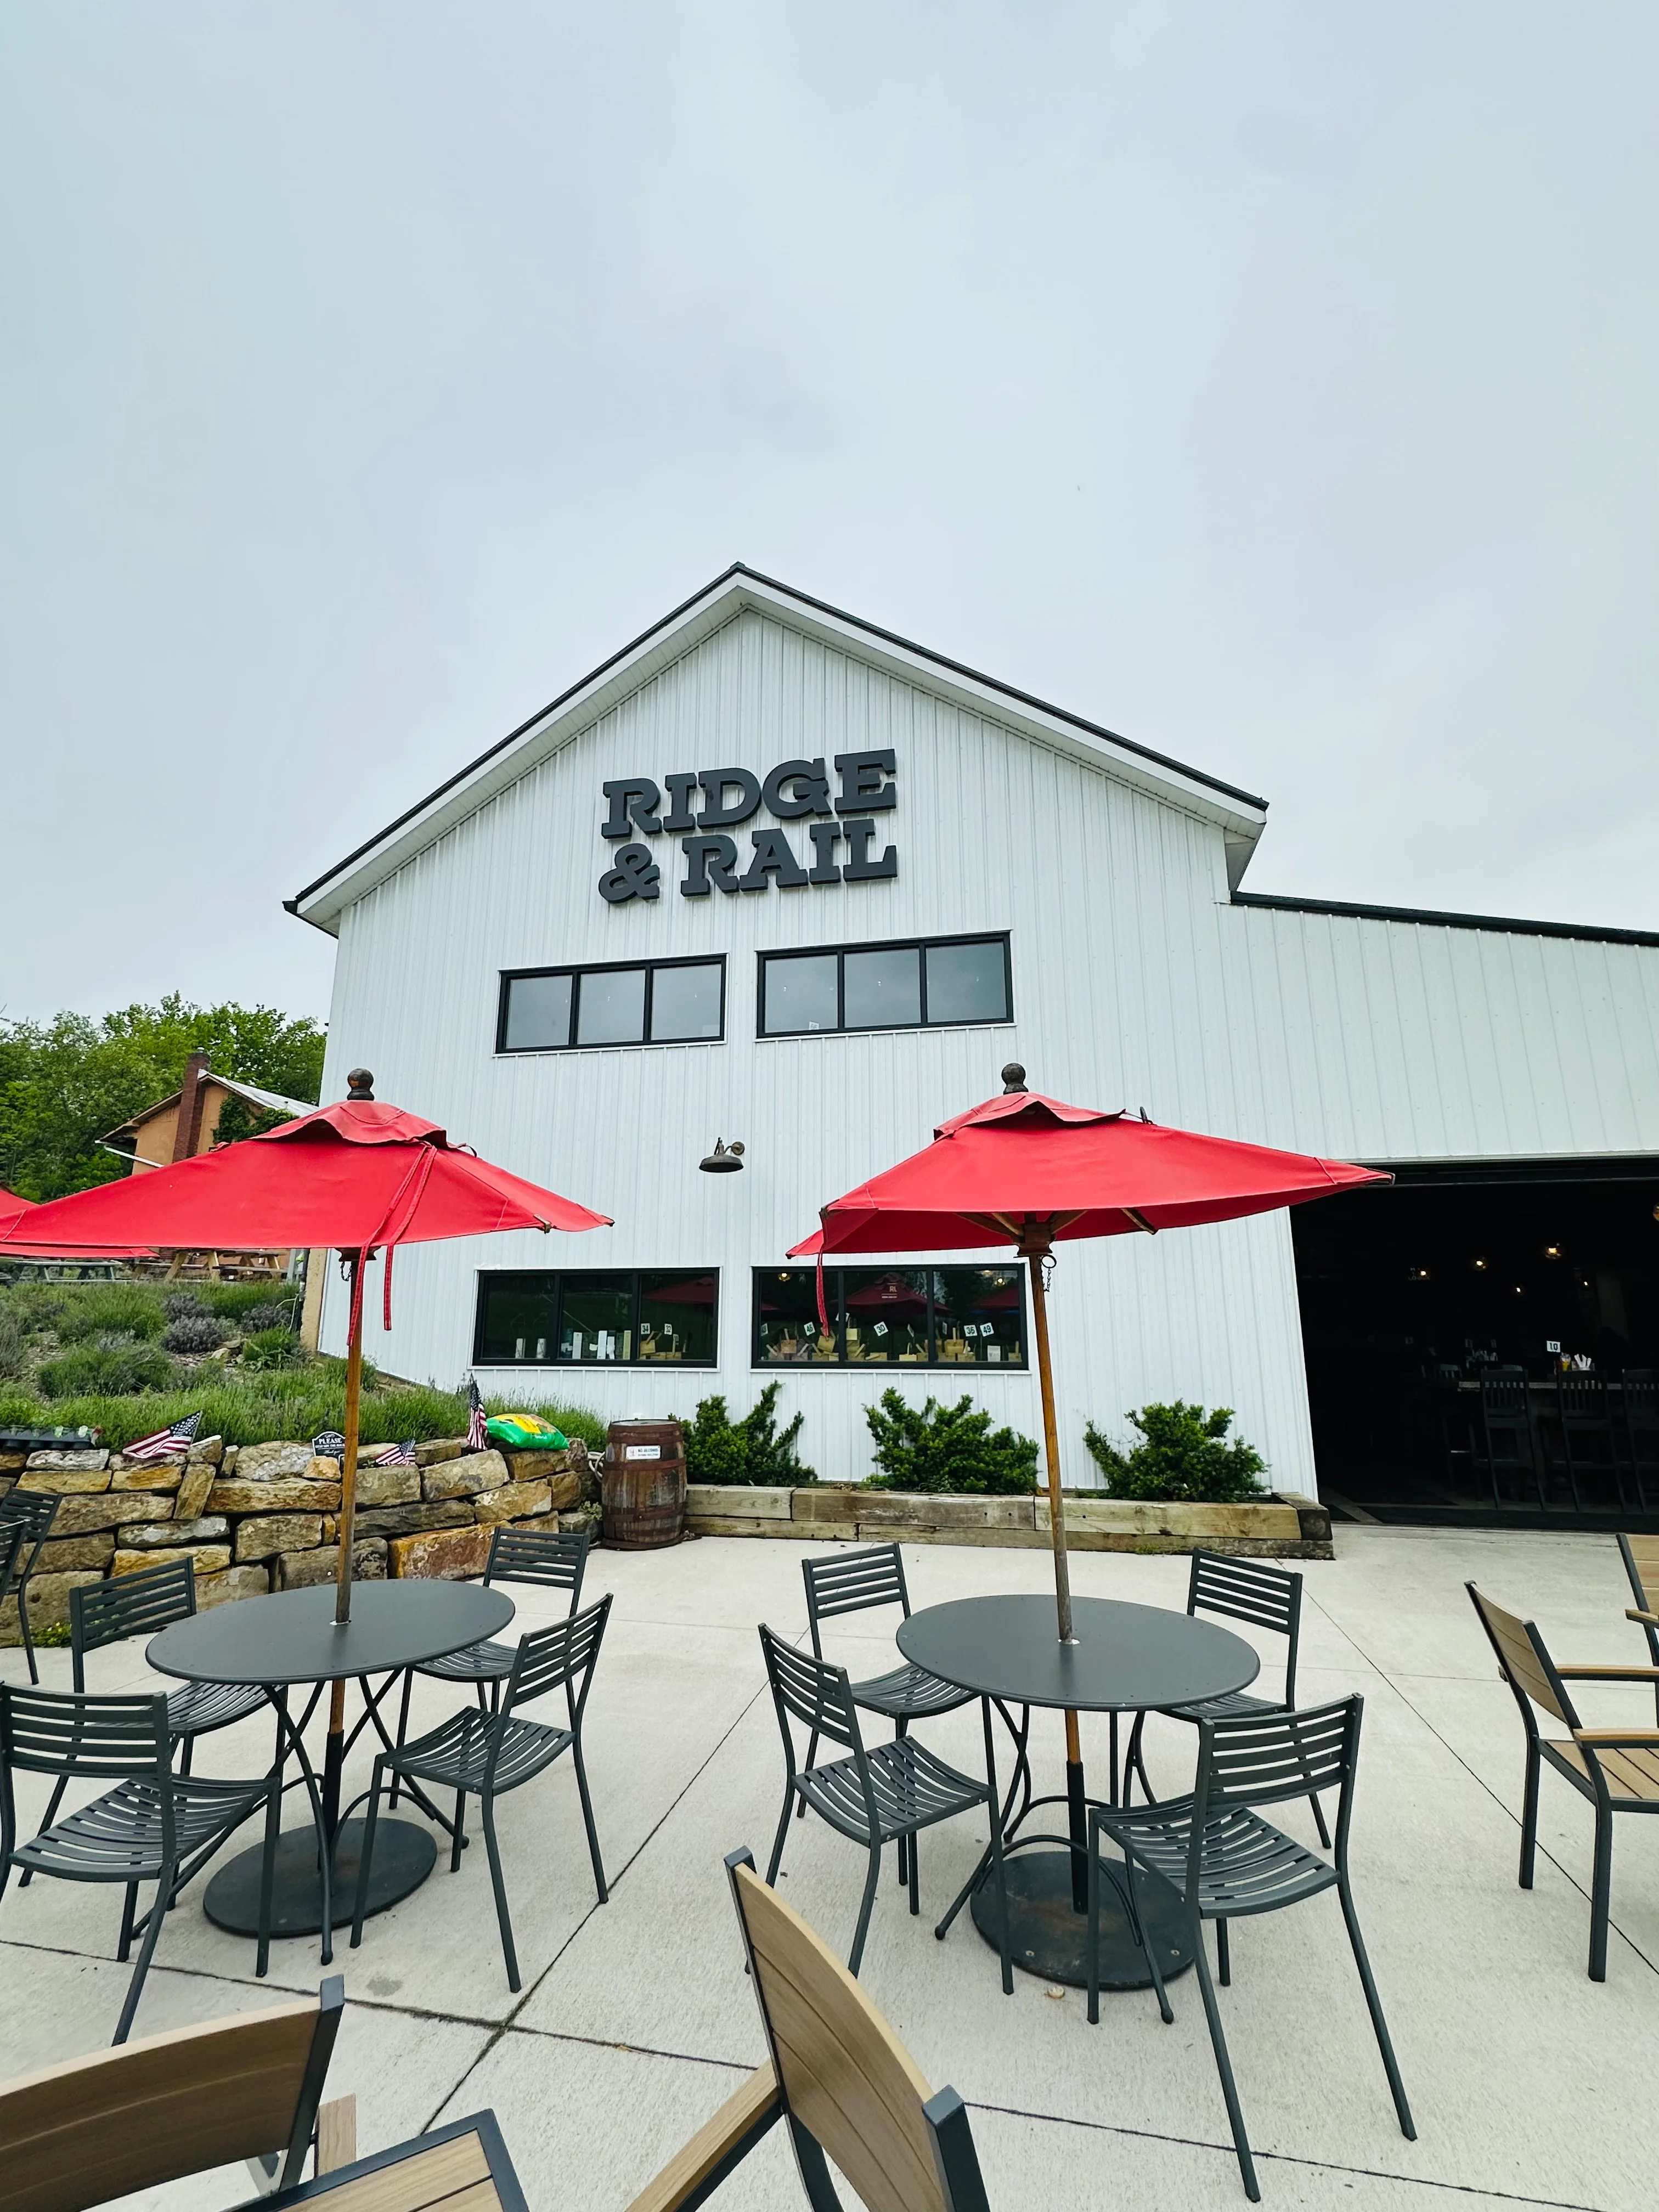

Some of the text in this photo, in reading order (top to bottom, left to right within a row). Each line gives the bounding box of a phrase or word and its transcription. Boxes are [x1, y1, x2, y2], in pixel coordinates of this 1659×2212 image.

[601, 749, 896, 839] RIDGE
[598, 819, 898, 904] & RAIL
[642, 1325, 649, 1333] 34
[876, 1324, 885, 1334] 30
[966, 1326, 975, 1335] 36
[983, 1325, 991, 1334] 49
[1549, 1342, 1558, 1351] 10
